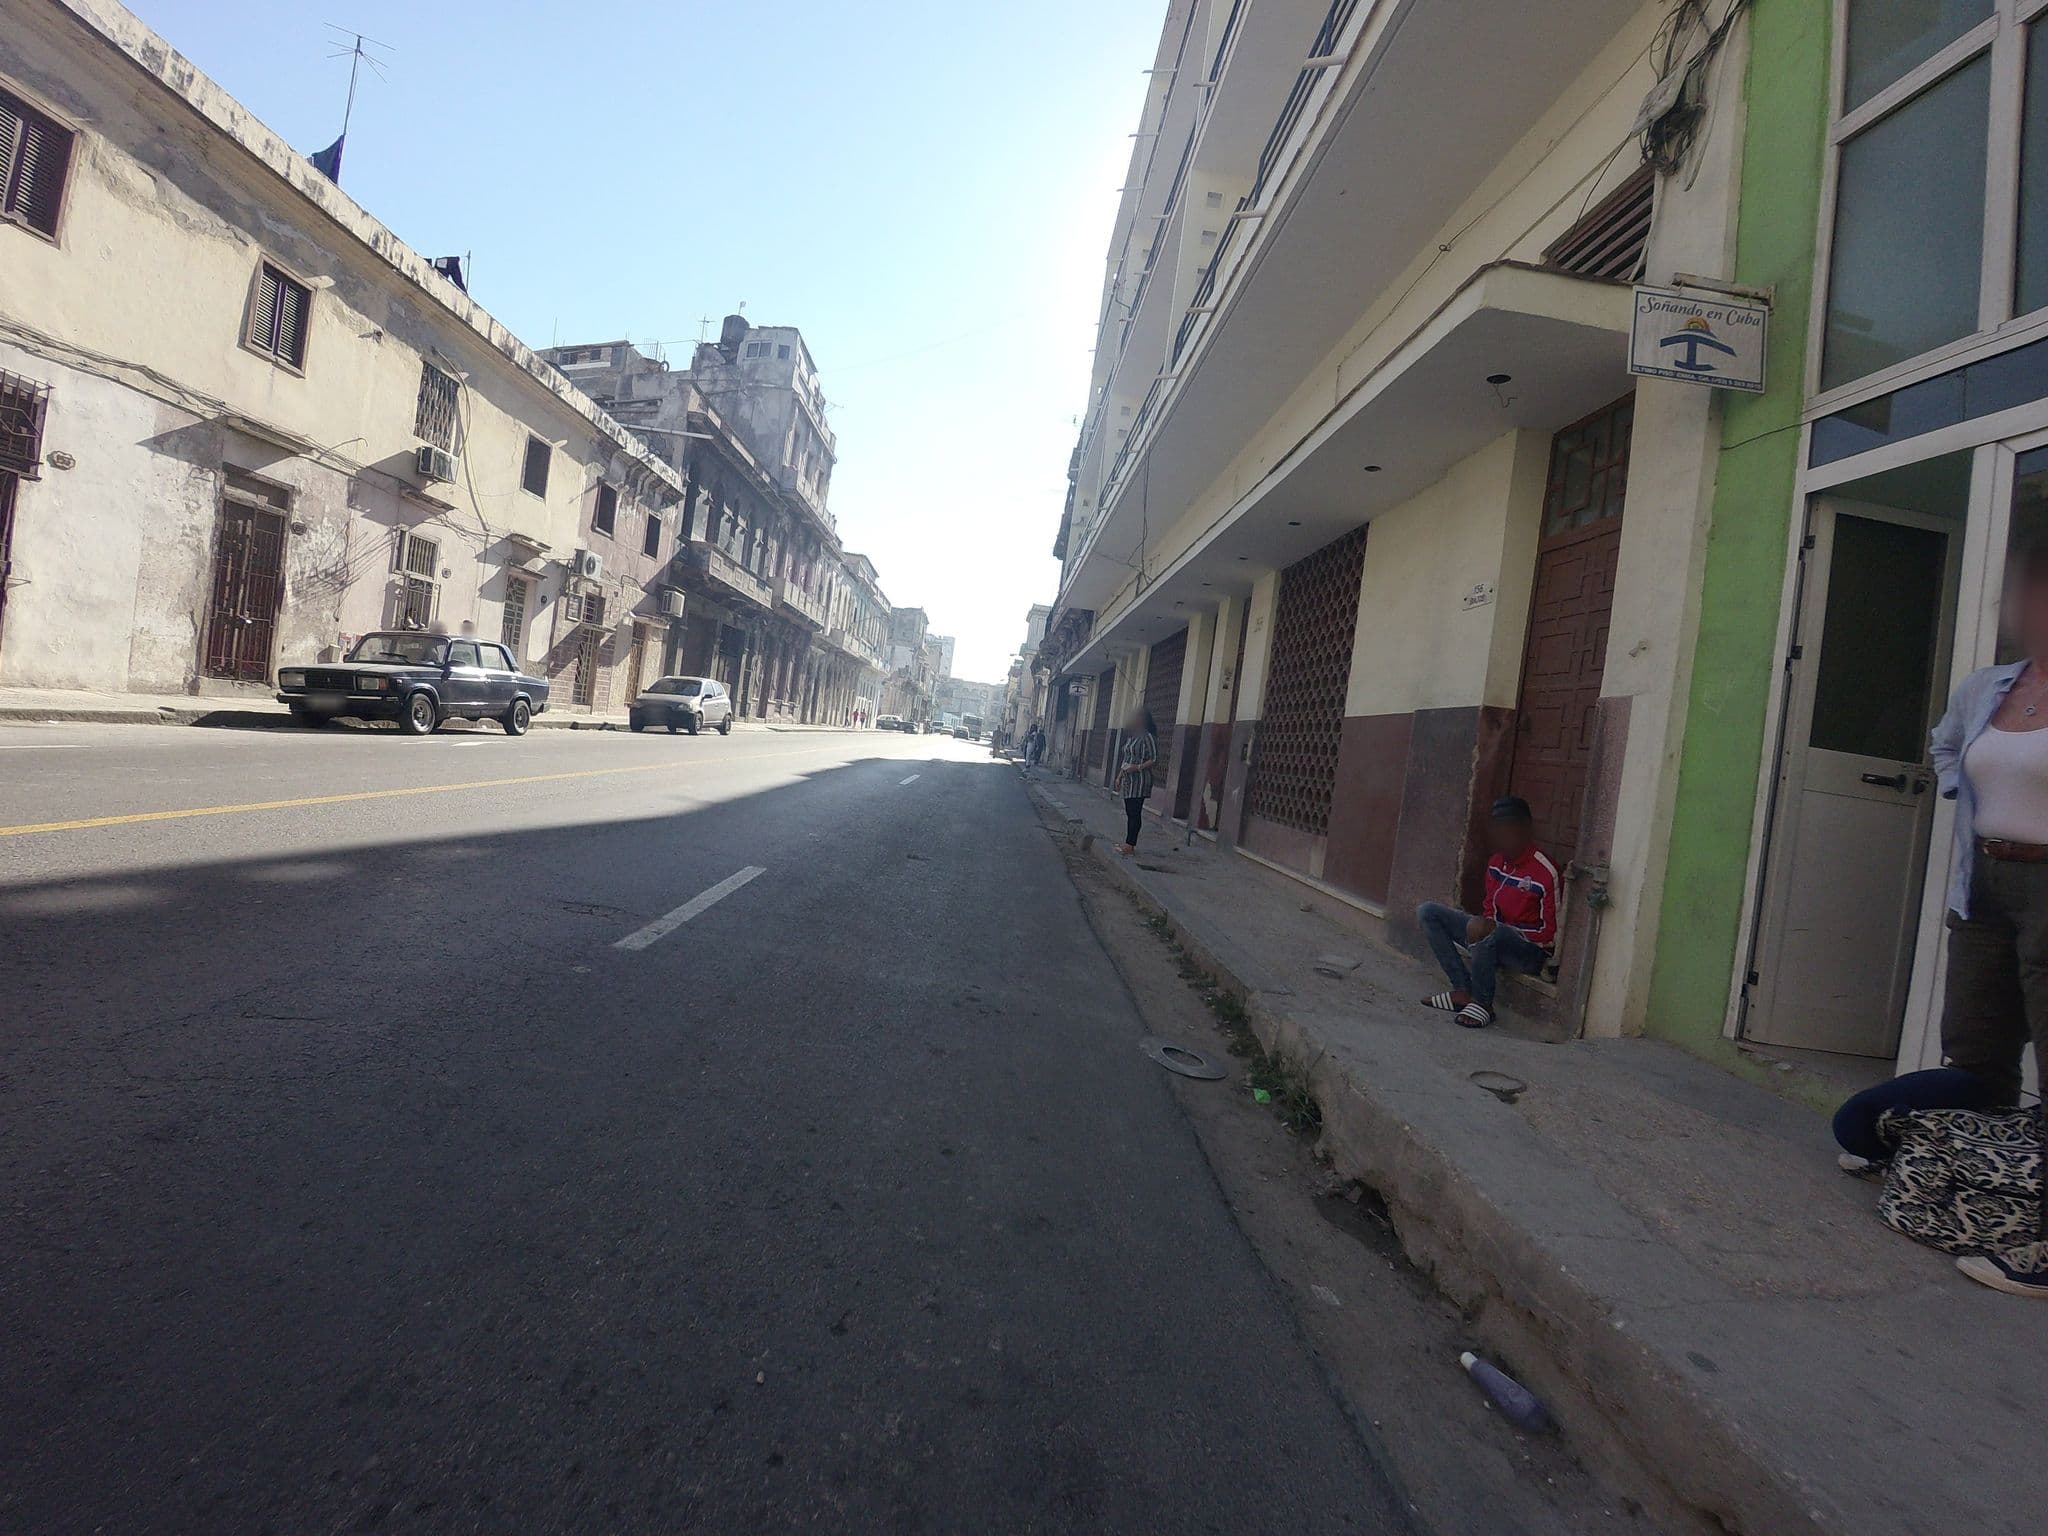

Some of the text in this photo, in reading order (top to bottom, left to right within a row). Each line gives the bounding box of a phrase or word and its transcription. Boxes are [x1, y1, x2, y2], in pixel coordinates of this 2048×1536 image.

[1640, 297, 1761, 327] Soñando en Cuba
